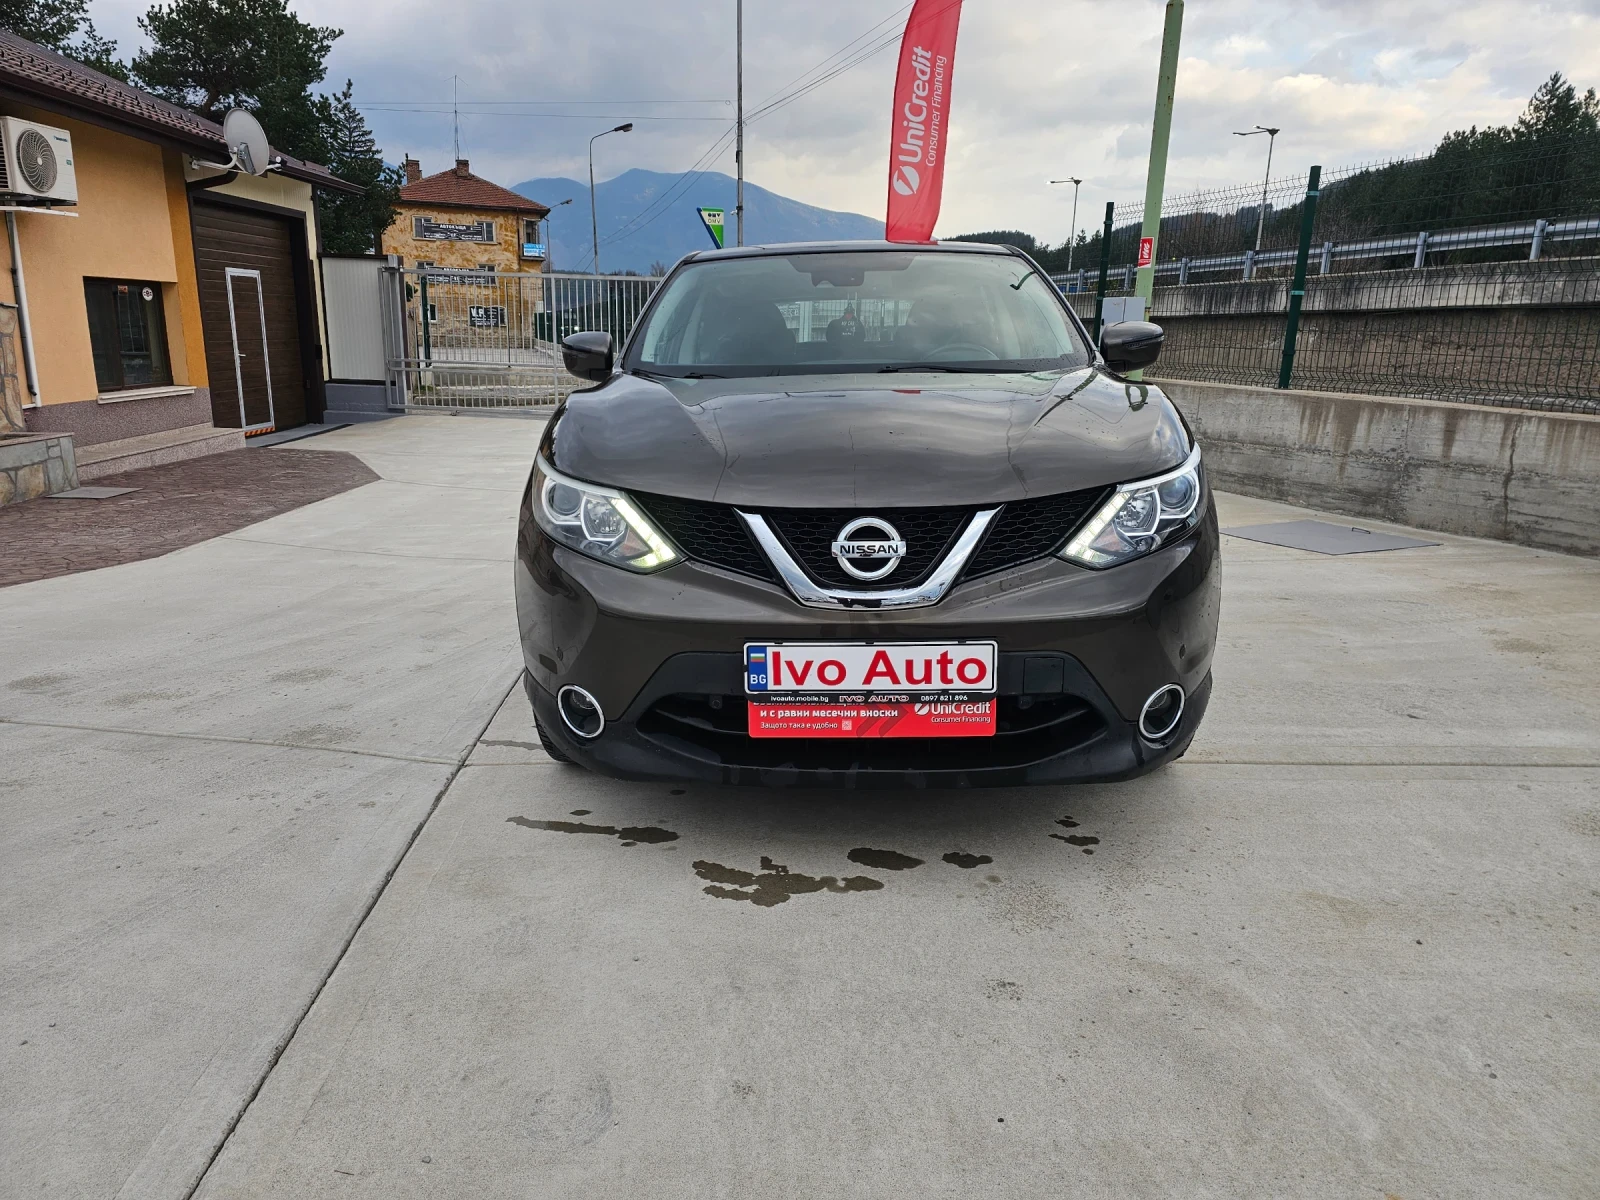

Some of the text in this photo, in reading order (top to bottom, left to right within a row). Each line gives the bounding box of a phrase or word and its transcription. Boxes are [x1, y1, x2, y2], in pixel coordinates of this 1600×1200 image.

[898, 46, 932, 163] UniCredit
[925, 55, 947, 167] Consumer Financing
[839, 545, 898, 553] NISSAN
[750, 650, 987, 686] BG Ivo Auto
[778, 710, 810, 719] равни
[860, 709, 898, 717] вноски
[931, 701, 991, 714] UniCredit
[760, 722, 788, 730] Защото
[812, 721, 838, 730] удобно
